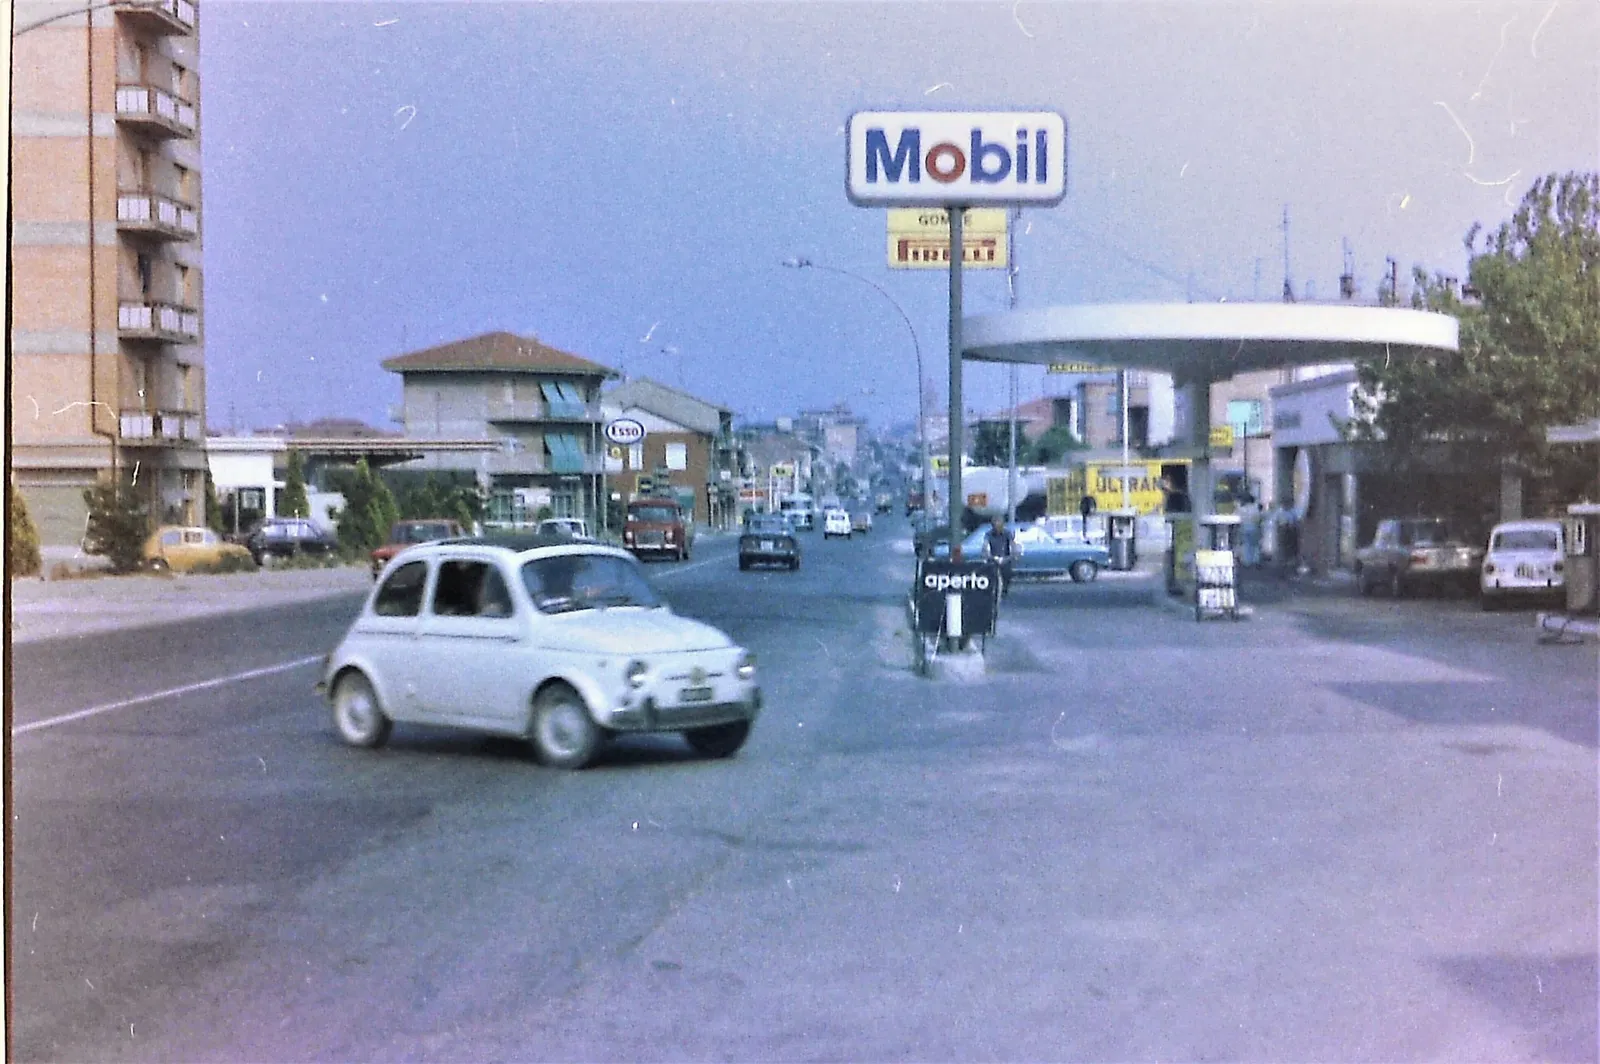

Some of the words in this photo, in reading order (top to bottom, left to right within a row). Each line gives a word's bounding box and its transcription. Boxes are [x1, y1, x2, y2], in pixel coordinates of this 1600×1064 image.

[866, 128, 1048, 183] Mobil
[918, 214, 972, 226] GOME
[924, 571, 989, 591] aperto
